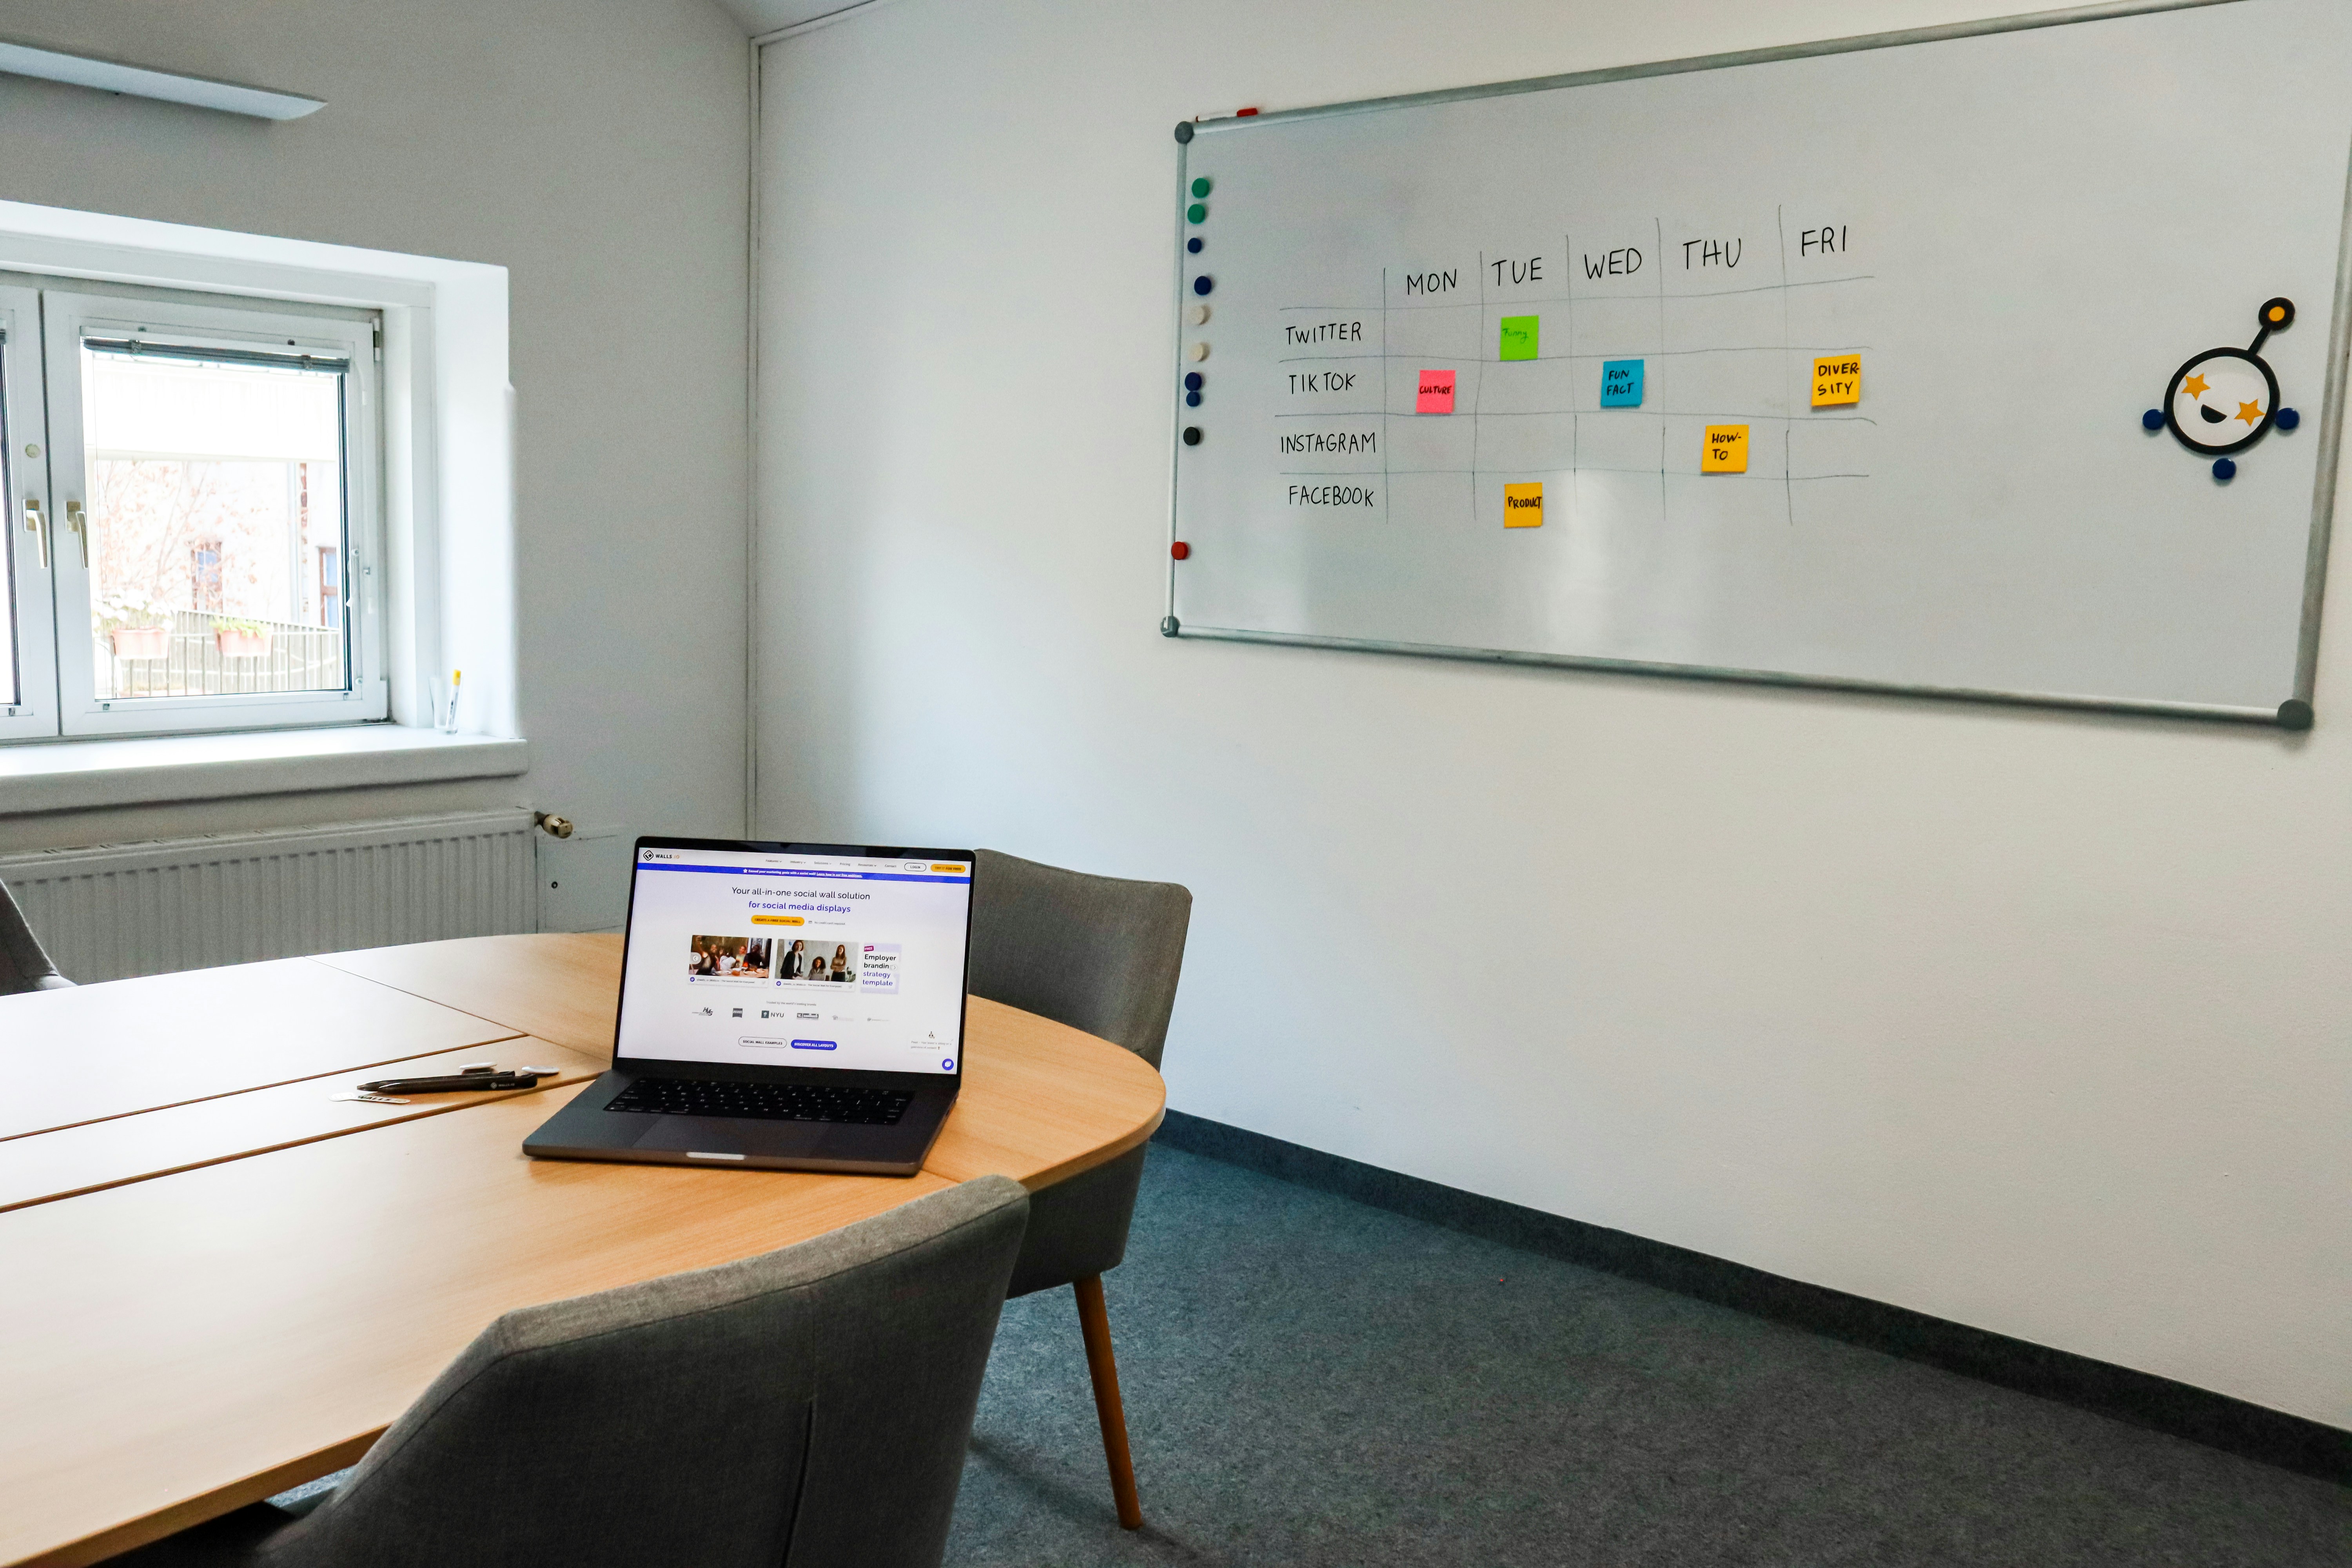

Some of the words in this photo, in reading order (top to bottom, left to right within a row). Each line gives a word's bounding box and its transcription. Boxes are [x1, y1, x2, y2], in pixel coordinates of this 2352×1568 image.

[1407, 269, 1457, 295] MON
[1492, 258, 1543, 286] TUE
[1584, 248, 1642, 279] WED
[1683, 238, 1741, 269] THU
[1801, 225, 1846, 256] FRI
[1285, 322, 1361, 345] TWITTER
[1608, 370, 1630, 381] FUN
[1818, 362, 1860, 377] DIVER-
[1419, 385, 1452, 395] CULTURE
[1607, 383, 1634, 396] FACT
[1818, 382, 1853, 396] SITY
[1281, 432, 1376, 454] INSTAGRAM
[1712, 433, 1742, 443] HOW-
[1713, 449, 1728, 461] TO
[1289, 485, 1374, 507] FACEBOOK
[1508, 496, 1542, 509] PRODUCT
[751, 887, 791, 897] all-in-one
[794, 889, 817, 898] social
[838, 892, 870, 900] solution
[817, 904, 851, 914] displays
[864, 962, 893, 971] brandin
